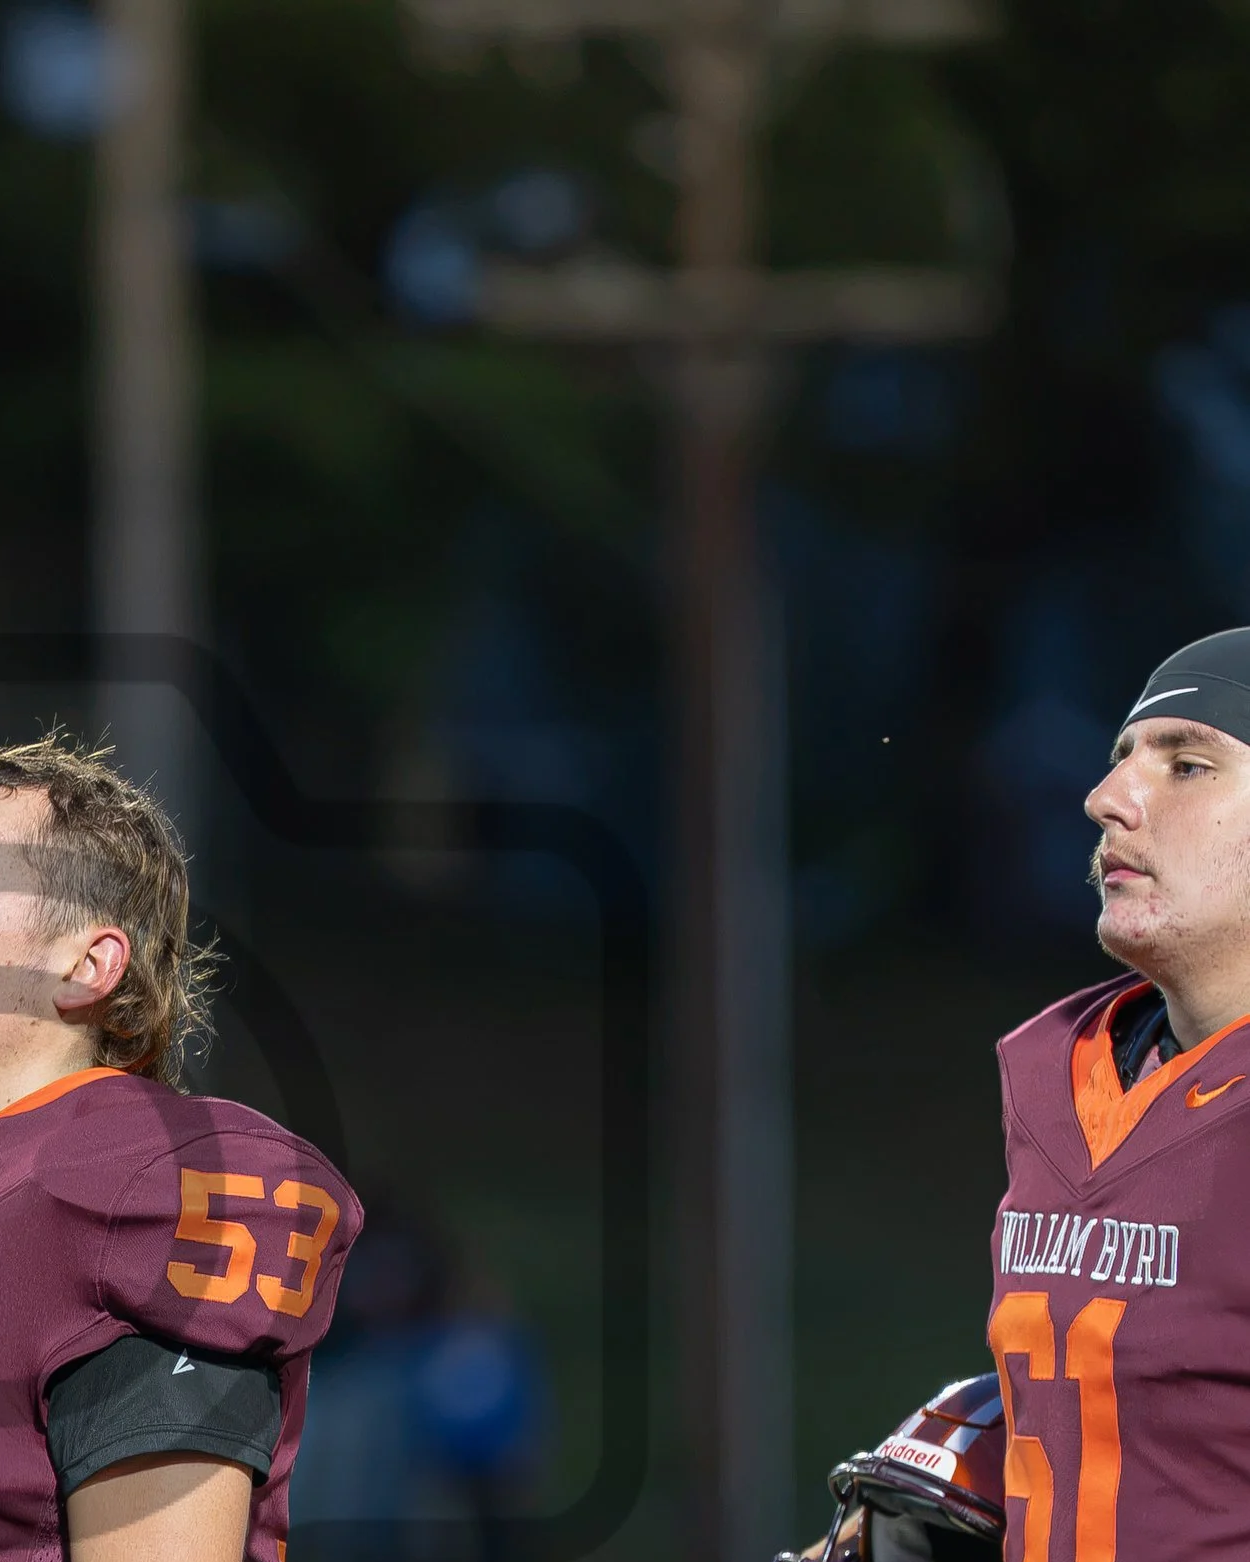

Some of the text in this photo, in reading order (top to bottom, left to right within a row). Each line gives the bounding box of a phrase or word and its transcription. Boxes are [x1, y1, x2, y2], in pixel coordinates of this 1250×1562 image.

[166, 1168, 341, 1318] 53
[1000, 1211, 1180, 1287] WILLIAM BYRD
[879, 1441, 942, 1469] Riddell
